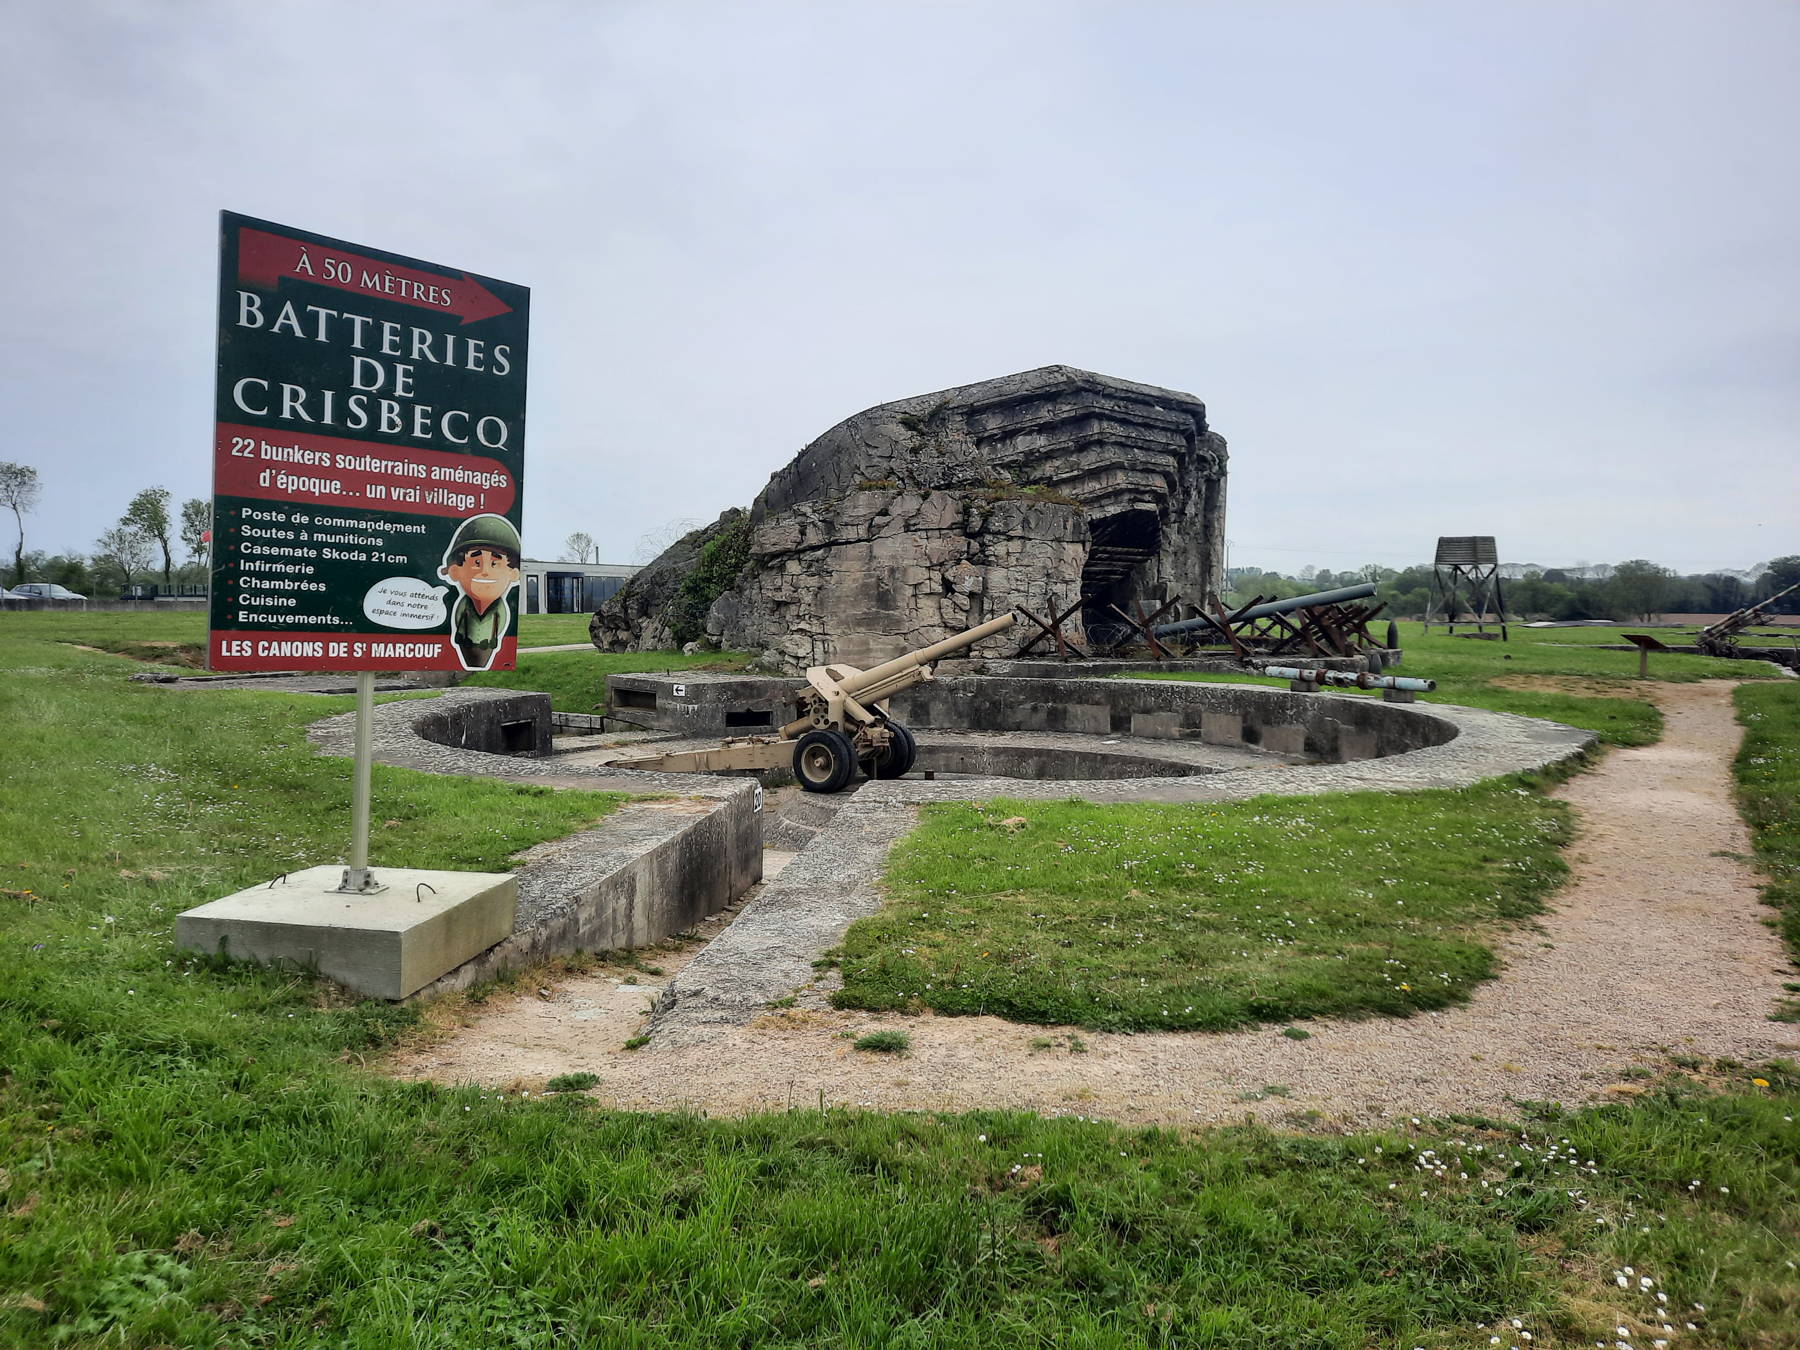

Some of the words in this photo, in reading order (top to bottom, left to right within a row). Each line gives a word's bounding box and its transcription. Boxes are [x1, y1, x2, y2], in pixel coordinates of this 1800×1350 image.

[295, 247, 315, 276] À
[323, 259, 351, 284] 50
[360, 270, 451, 307] MÈTRES
[235, 290, 511, 376] BATTERIES
[350, 355, 414, 397] DE
[232, 377, 509, 451] CRISBECQ
[231, 437, 255, 457] 22
[261, 441, 330, 467] bunkers
[336, 455, 426, 479] souterrains
[431, 465, 507, 490] aménagés
[366, 484, 385, 499] un
[390, 485, 420, 503] vrai
[425, 489, 475, 512] village
[480, 493, 485, 509] !
[241, 508, 286, 523] Poste
[291, 512, 309, 524] de
[314, 514, 426, 534] commandement
[241, 524, 295, 540] Soutes
[300, 528, 308, 541] à
[313, 530, 383, 546] munitions
[240, 542, 317, 558] Casemate
[322, 547, 367, 562] Skoda
[371, 552, 407, 564] 21cm
[240, 559, 314, 575] Infirmerie
[239, 576, 326, 592] Chambrées
[239, 594, 296, 607] Cuisine
[386, 598, 404, 607] dans
[410, 591, 439, 601] attends
[238, 611, 353, 625] Encuvements...
[372, 608, 397, 616] espace
[221, 640, 252, 657] LES
[258, 640, 323, 657] CANONS
[329, 641, 348, 657] DE
[371, 643, 442, 658] MARCOUF
